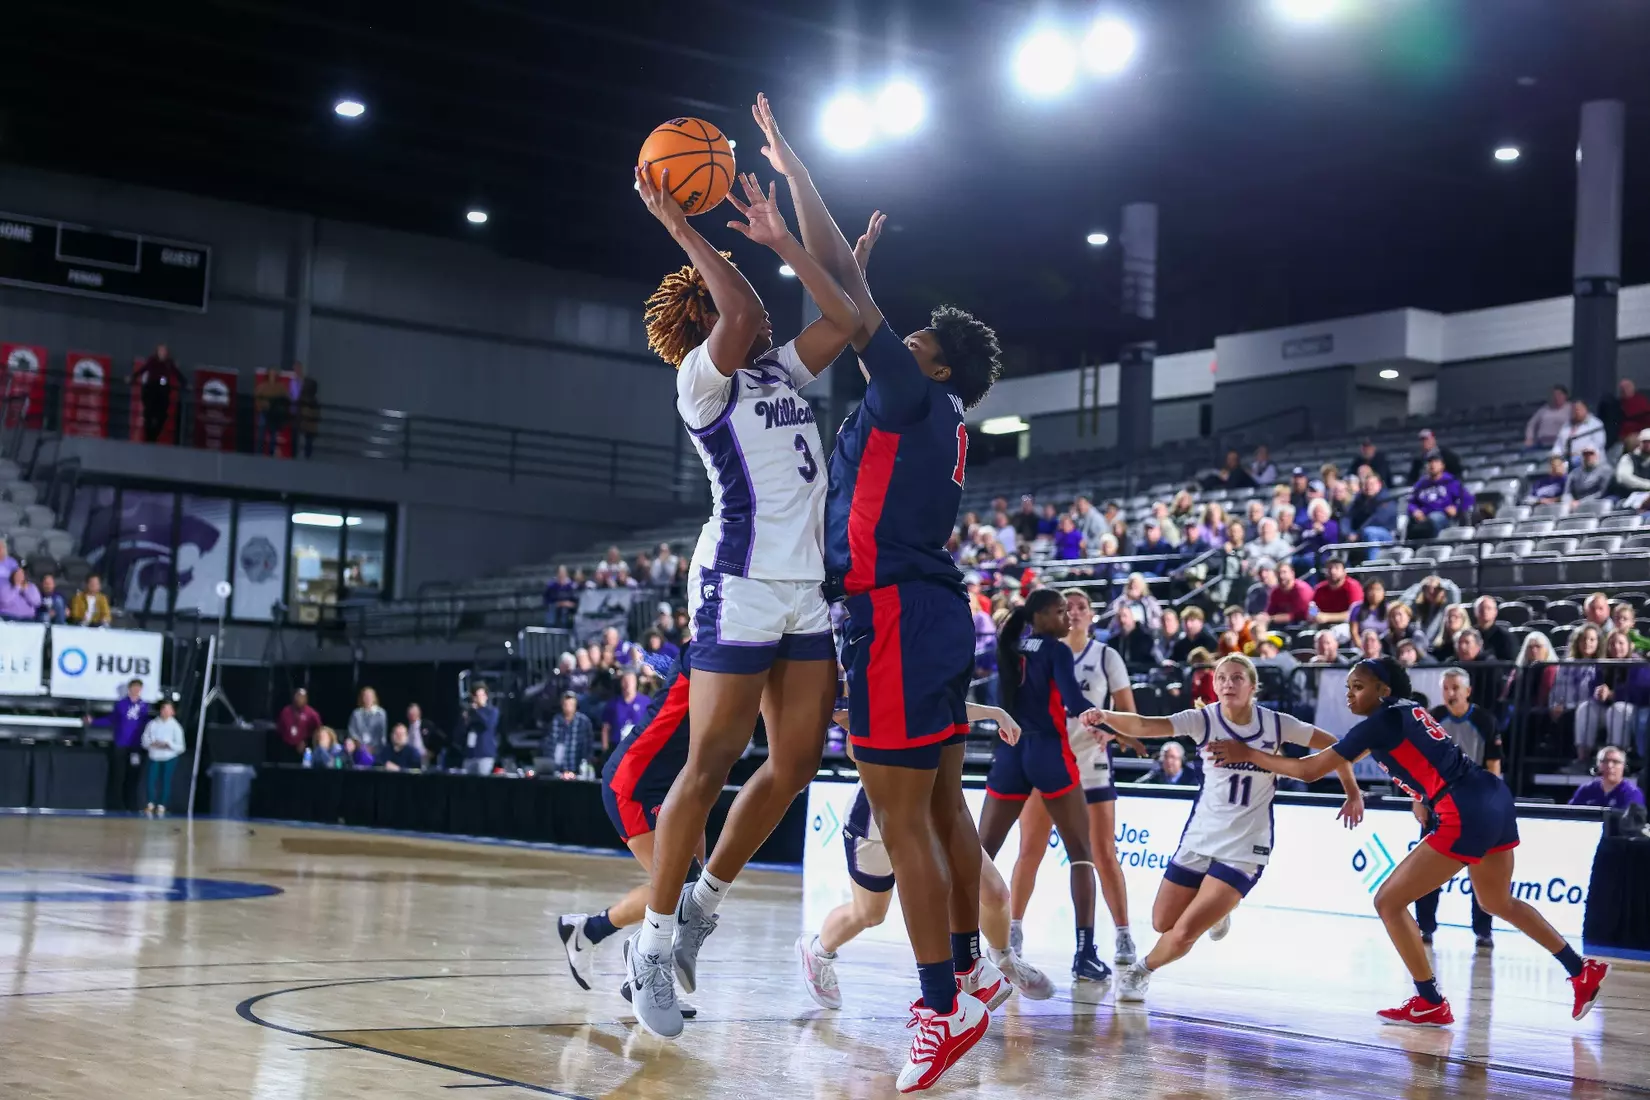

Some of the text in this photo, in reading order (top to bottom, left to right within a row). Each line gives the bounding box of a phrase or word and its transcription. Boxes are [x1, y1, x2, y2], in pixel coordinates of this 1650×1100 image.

[793, 433, 819, 484] 3
[95, 653, 151, 676] HUB
[1228, 773, 1253, 807] 11
[1115, 823, 1150, 845] Joe
